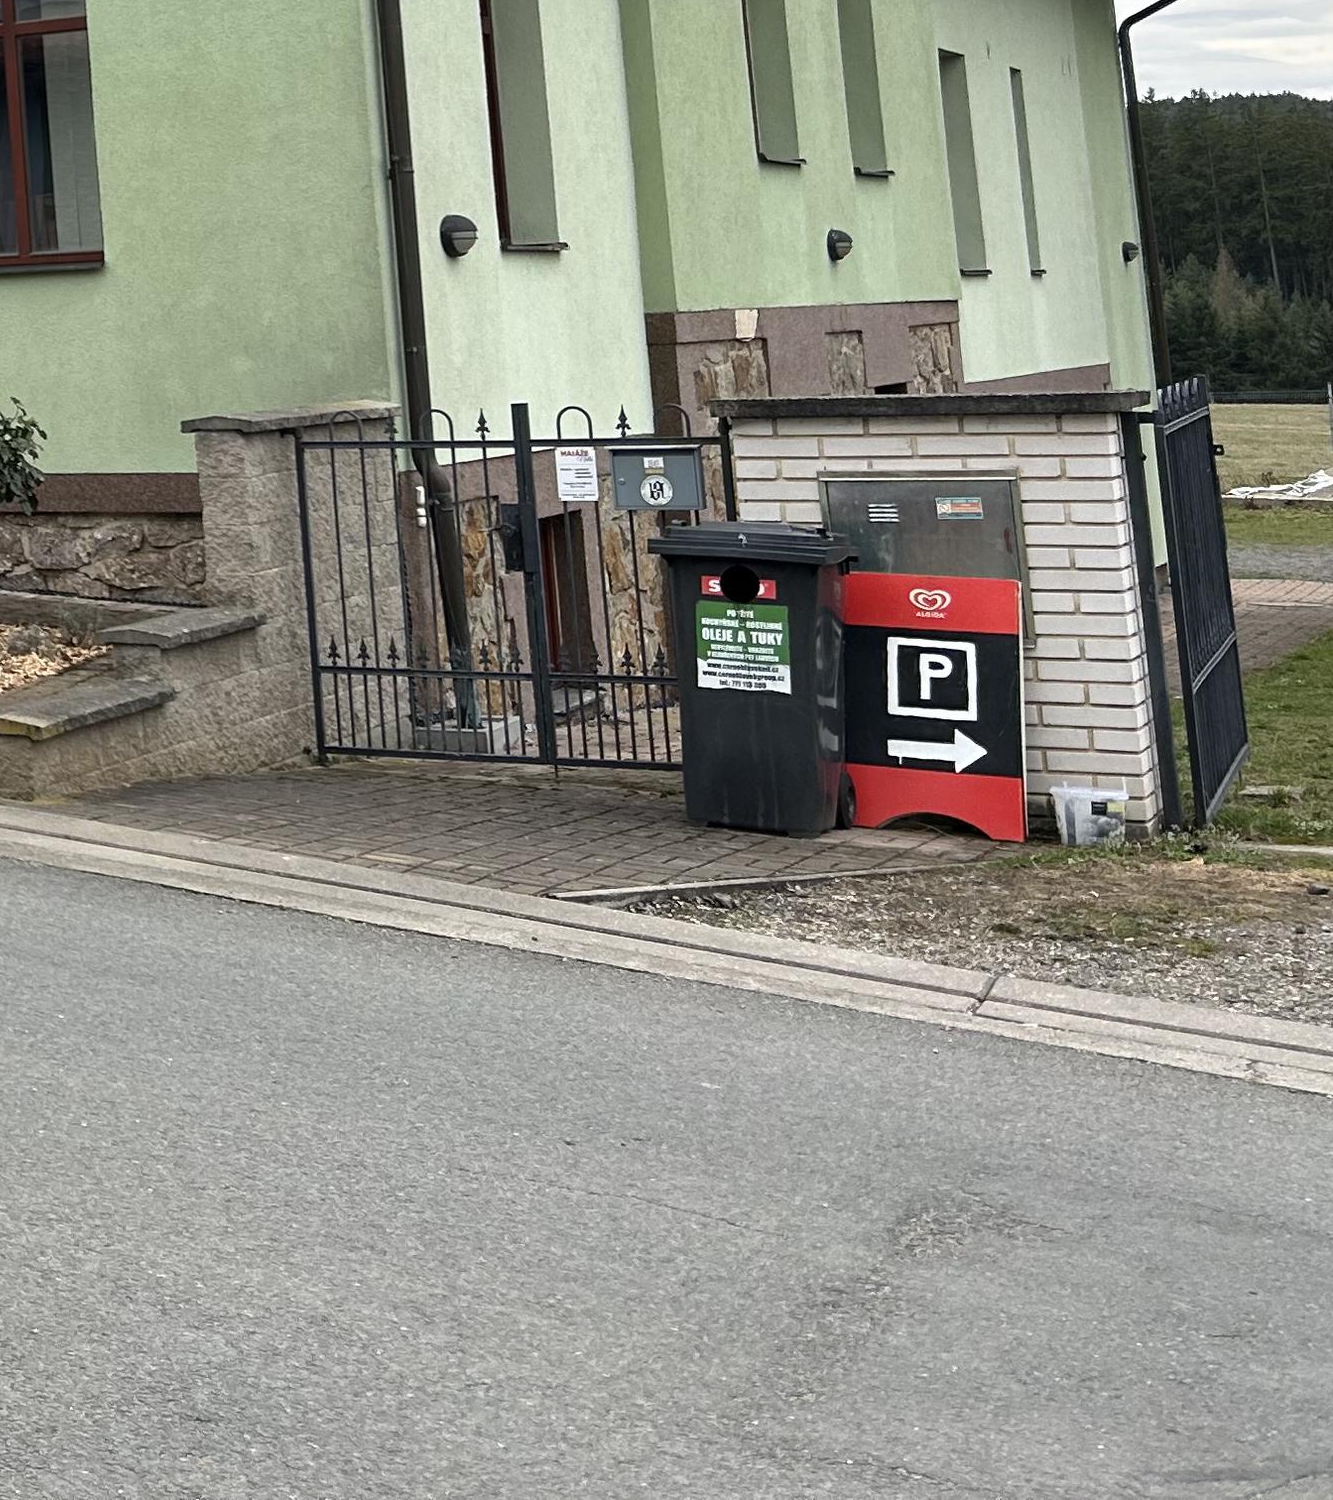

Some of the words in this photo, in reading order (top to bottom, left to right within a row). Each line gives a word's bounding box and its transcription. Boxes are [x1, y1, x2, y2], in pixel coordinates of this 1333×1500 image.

[701, 627, 733, 642] OLEJE
[737, 631, 747, 643] A
[749, 632, 783, 646] TUKY
[919, 653, 953, 700] P
